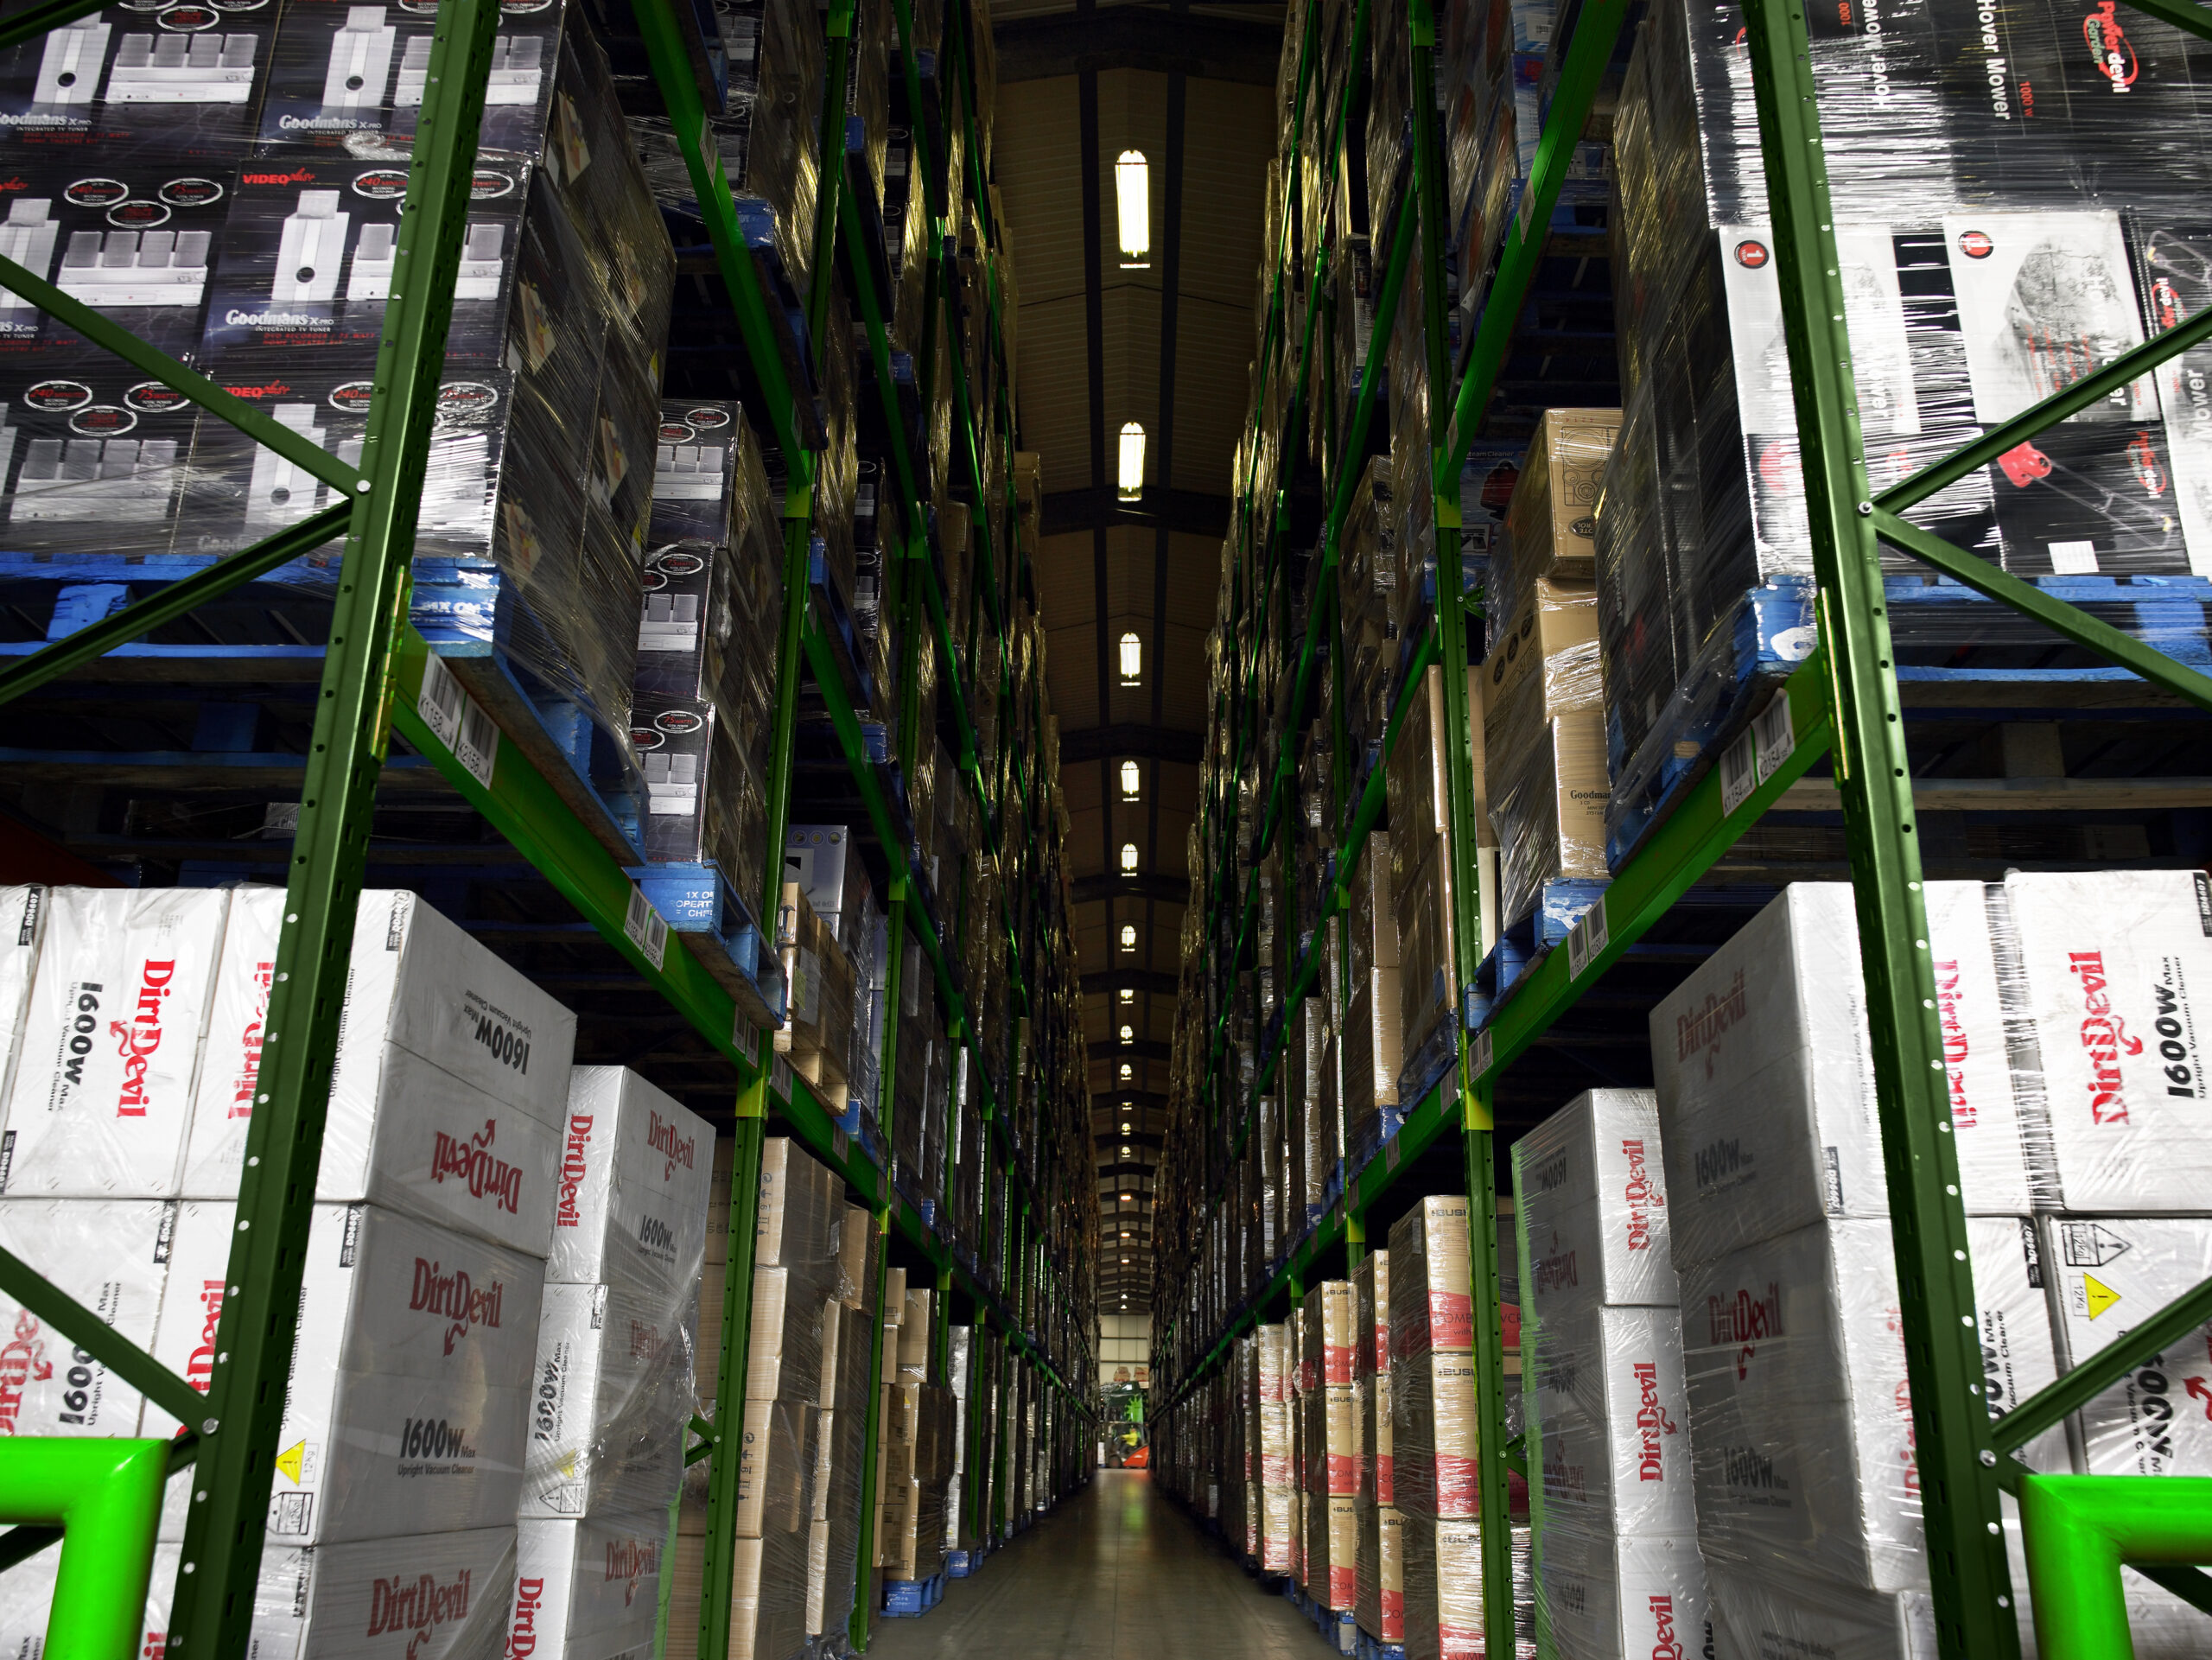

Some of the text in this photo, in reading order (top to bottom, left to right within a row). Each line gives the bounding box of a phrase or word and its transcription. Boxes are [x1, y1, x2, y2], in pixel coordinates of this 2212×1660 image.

[2087, 17, 2105, 64] Garden
[1986, 58, 2011, 120] Mower
[278, 114, 358, 130] Goodmans
[226, 309, 309, 326] Goodmans
[138, 389, 155, 399] 75
[24, 893, 40, 926] DD6607
[475, 1015, 531, 1076] 1600W
[2154, 956, 2196, 1098] 1600W Max
[2175, 957, 2206, 1099] Upright Vacuum Cleaner
[639, 1214, 672, 1251] 1600W
[2023, 1224, 2038, 1265] DD6607
[400, 1417, 476, 1460] 1600W Max
[398, 1463, 423, 1477] Upright
[424, 1463, 450, 1475] Vacuum
